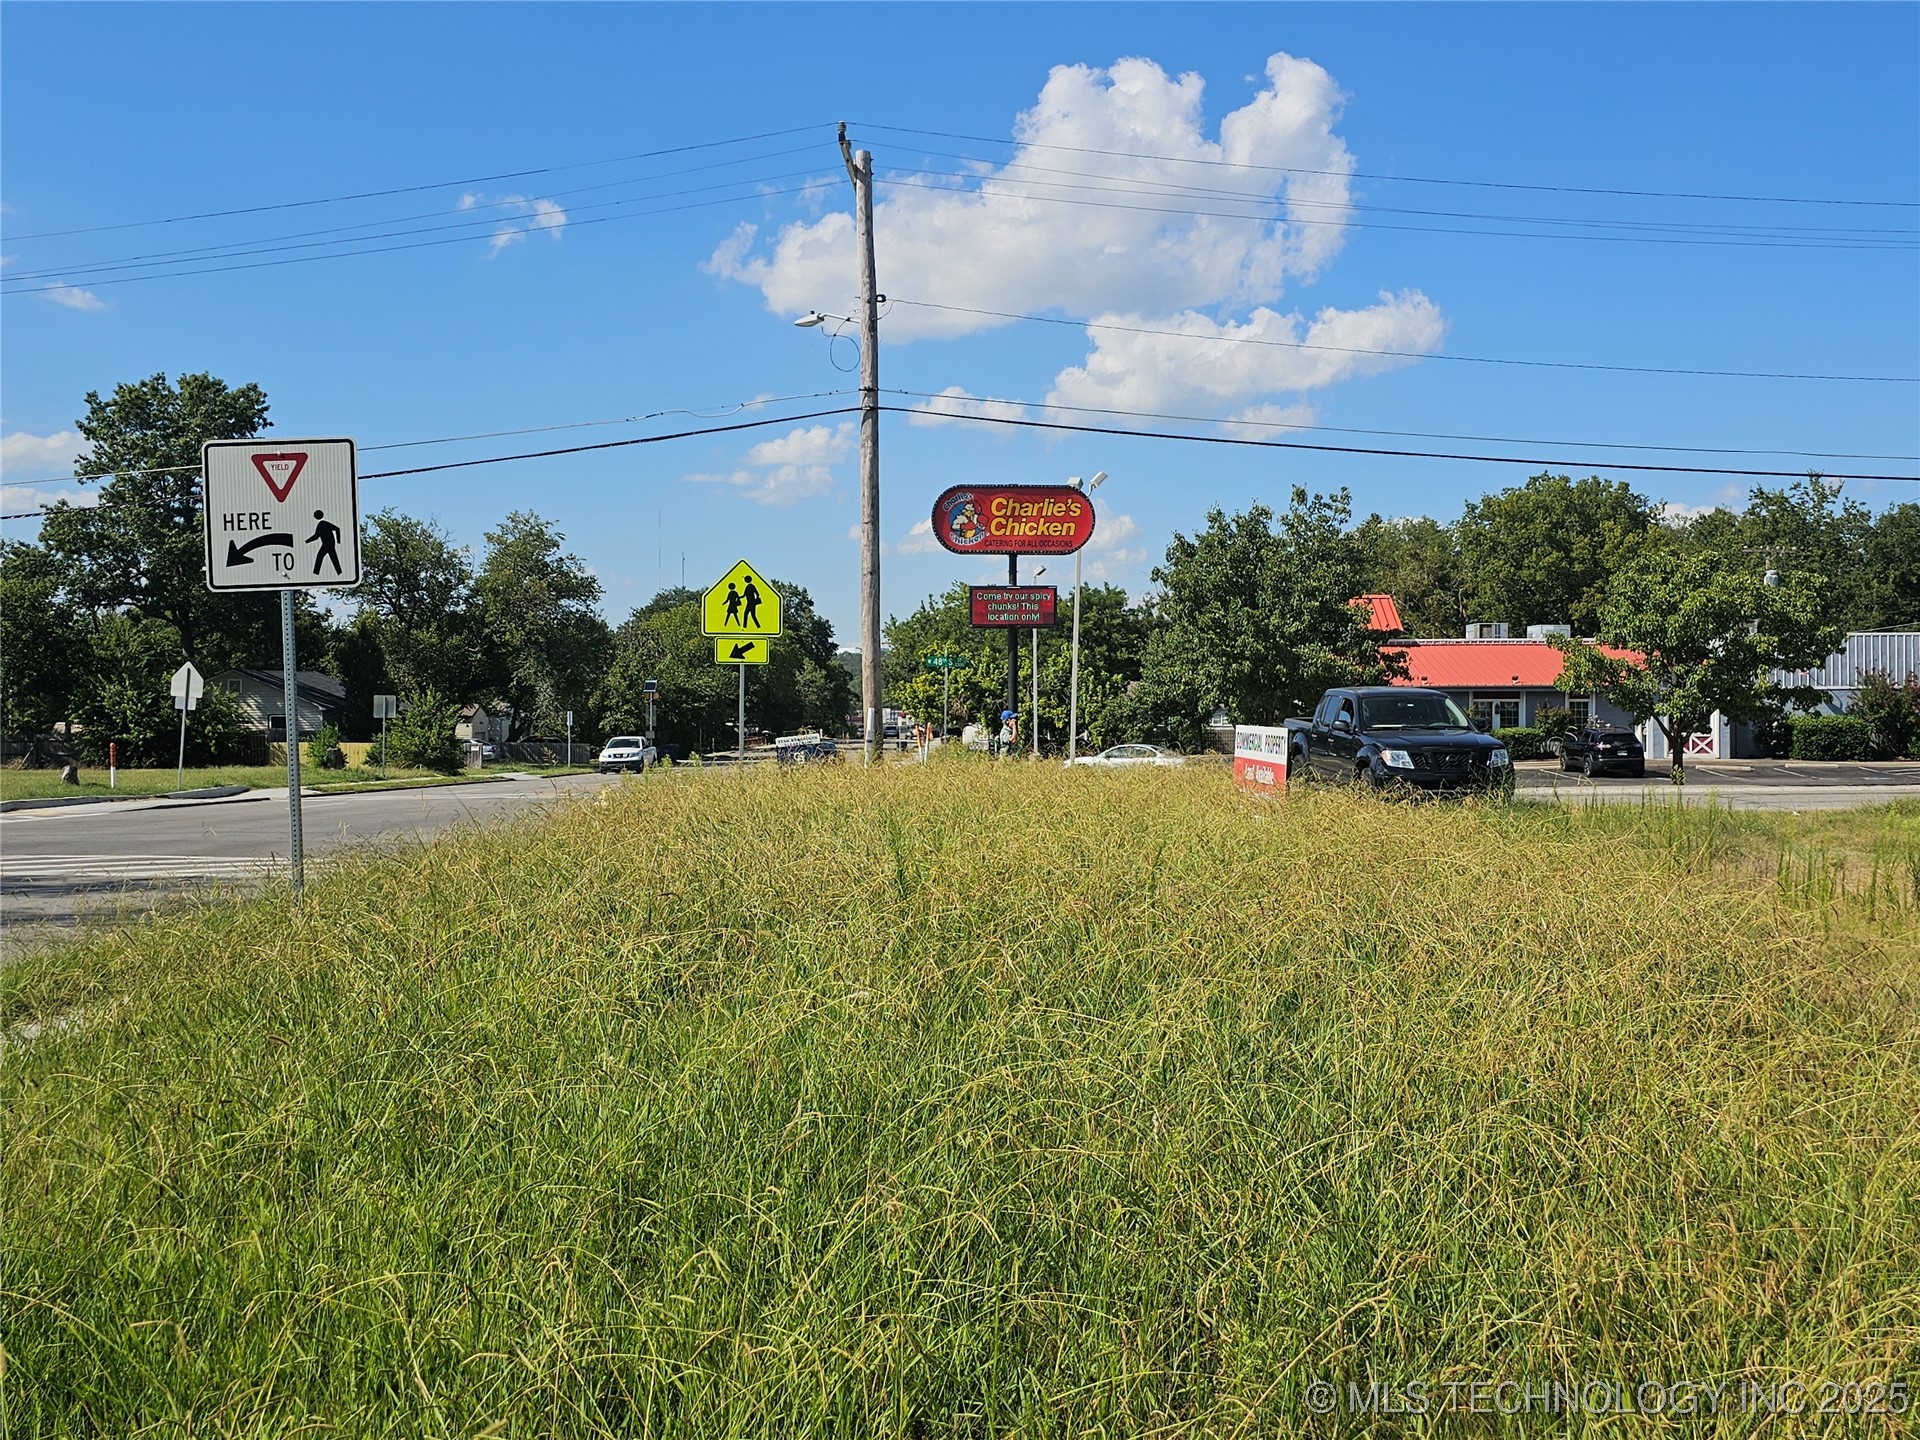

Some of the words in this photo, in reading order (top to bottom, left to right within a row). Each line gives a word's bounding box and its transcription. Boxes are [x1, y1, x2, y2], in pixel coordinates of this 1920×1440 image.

[270, 463, 289, 471] YIELD
[990, 497, 1082, 517] Charlie's
[223, 512, 272, 532] HERE
[990, 516, 1076, 537] Chicken
[984, 540, 1013, 548] CATERING
[1014, 540, 1027, 548] FOR
[1027, 540, 1038, 548] ALL
[1039, 540, 1073, 548] OCCASIONS
[272, 552, 295, 571] TO
[976, 592, 1001, 600] Come
[1003, 592, 1013, 601] try
[1030, 592, 1051, 602] spicy
[987, 602, 1019, 611] chunks!
[1021, 602, 1039, 610] This
[987, 613, 1019, 621] location
[1021, 612, 1040, 622] only!
[1265, 734, 1287, 756] PROPERTY
